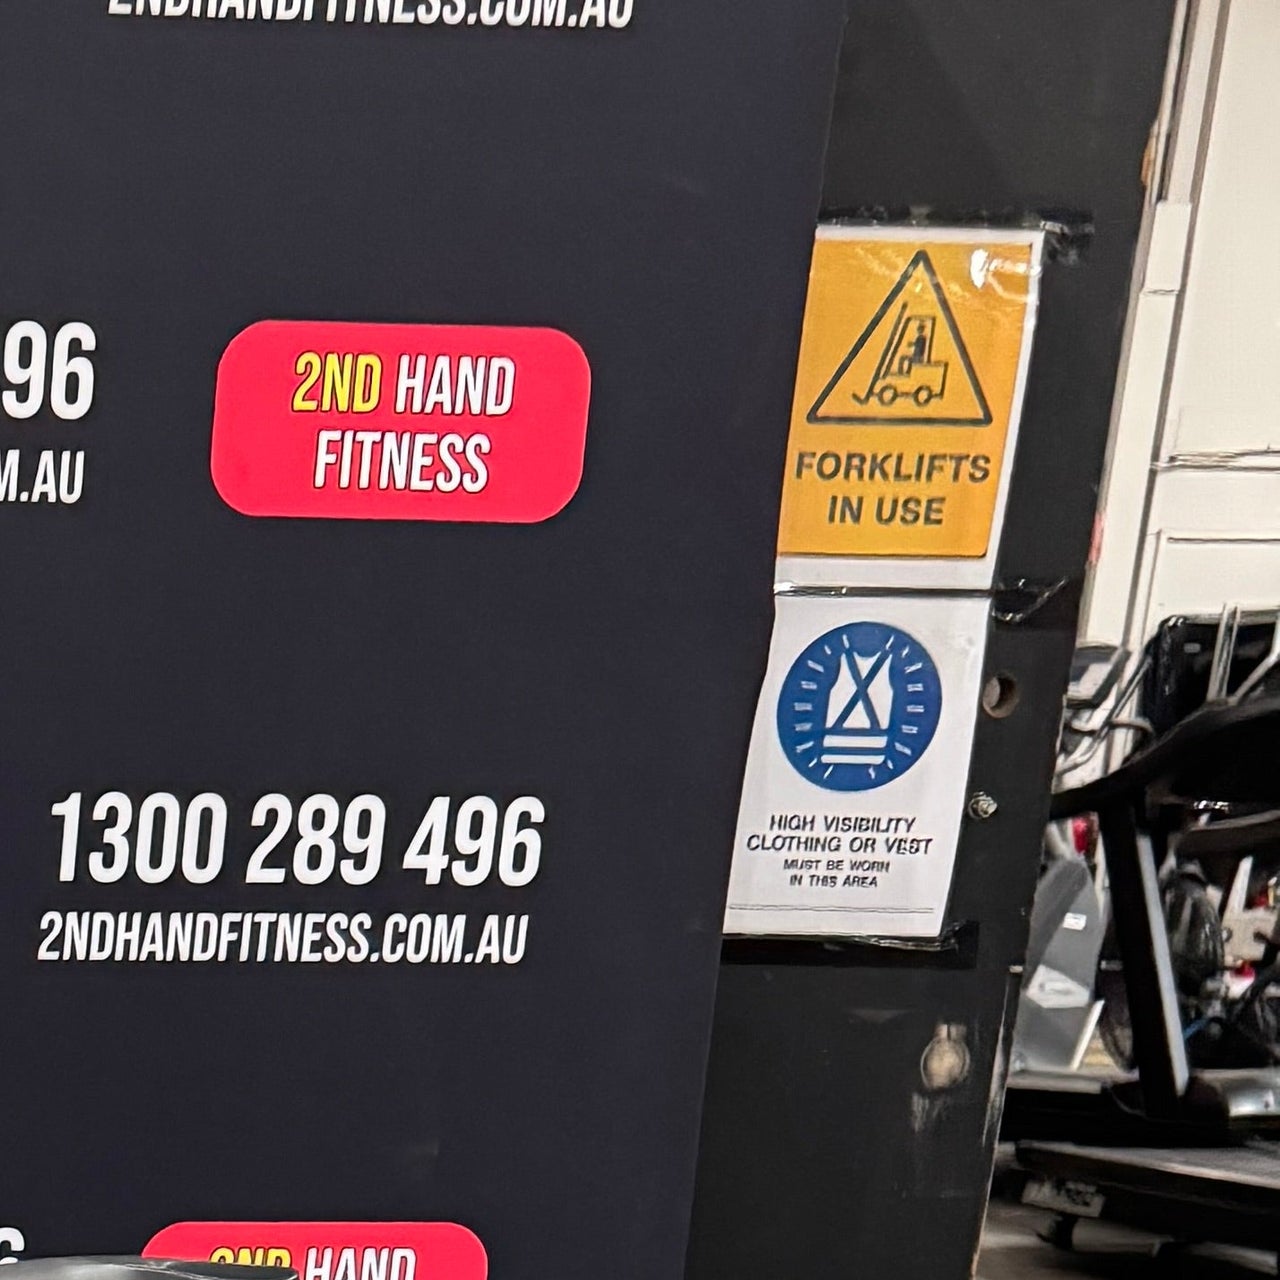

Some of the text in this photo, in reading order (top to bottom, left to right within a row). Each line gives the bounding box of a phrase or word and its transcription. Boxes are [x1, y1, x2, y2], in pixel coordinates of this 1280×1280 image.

[293, 352, 515, 415] 2ND HAND
[314, 430, 491, 493] FITNESS
[795, 451, 990, 485] FORKLIFTS
[828, 494, 944, 527] IN USE
[51, 791, 546, 887] 1300 289 496
[769, 814, 916, 834] HIGH VISIBILITY
[746, 834, 934, 855] CLOTHING OR VEST
[783, 858, 891, 873] MUST BE WORN
[789, 874, 878, 888] IN THIS AREA
[37, 910, 530, 964] 2NDHANDFITNESS.COM.AU
